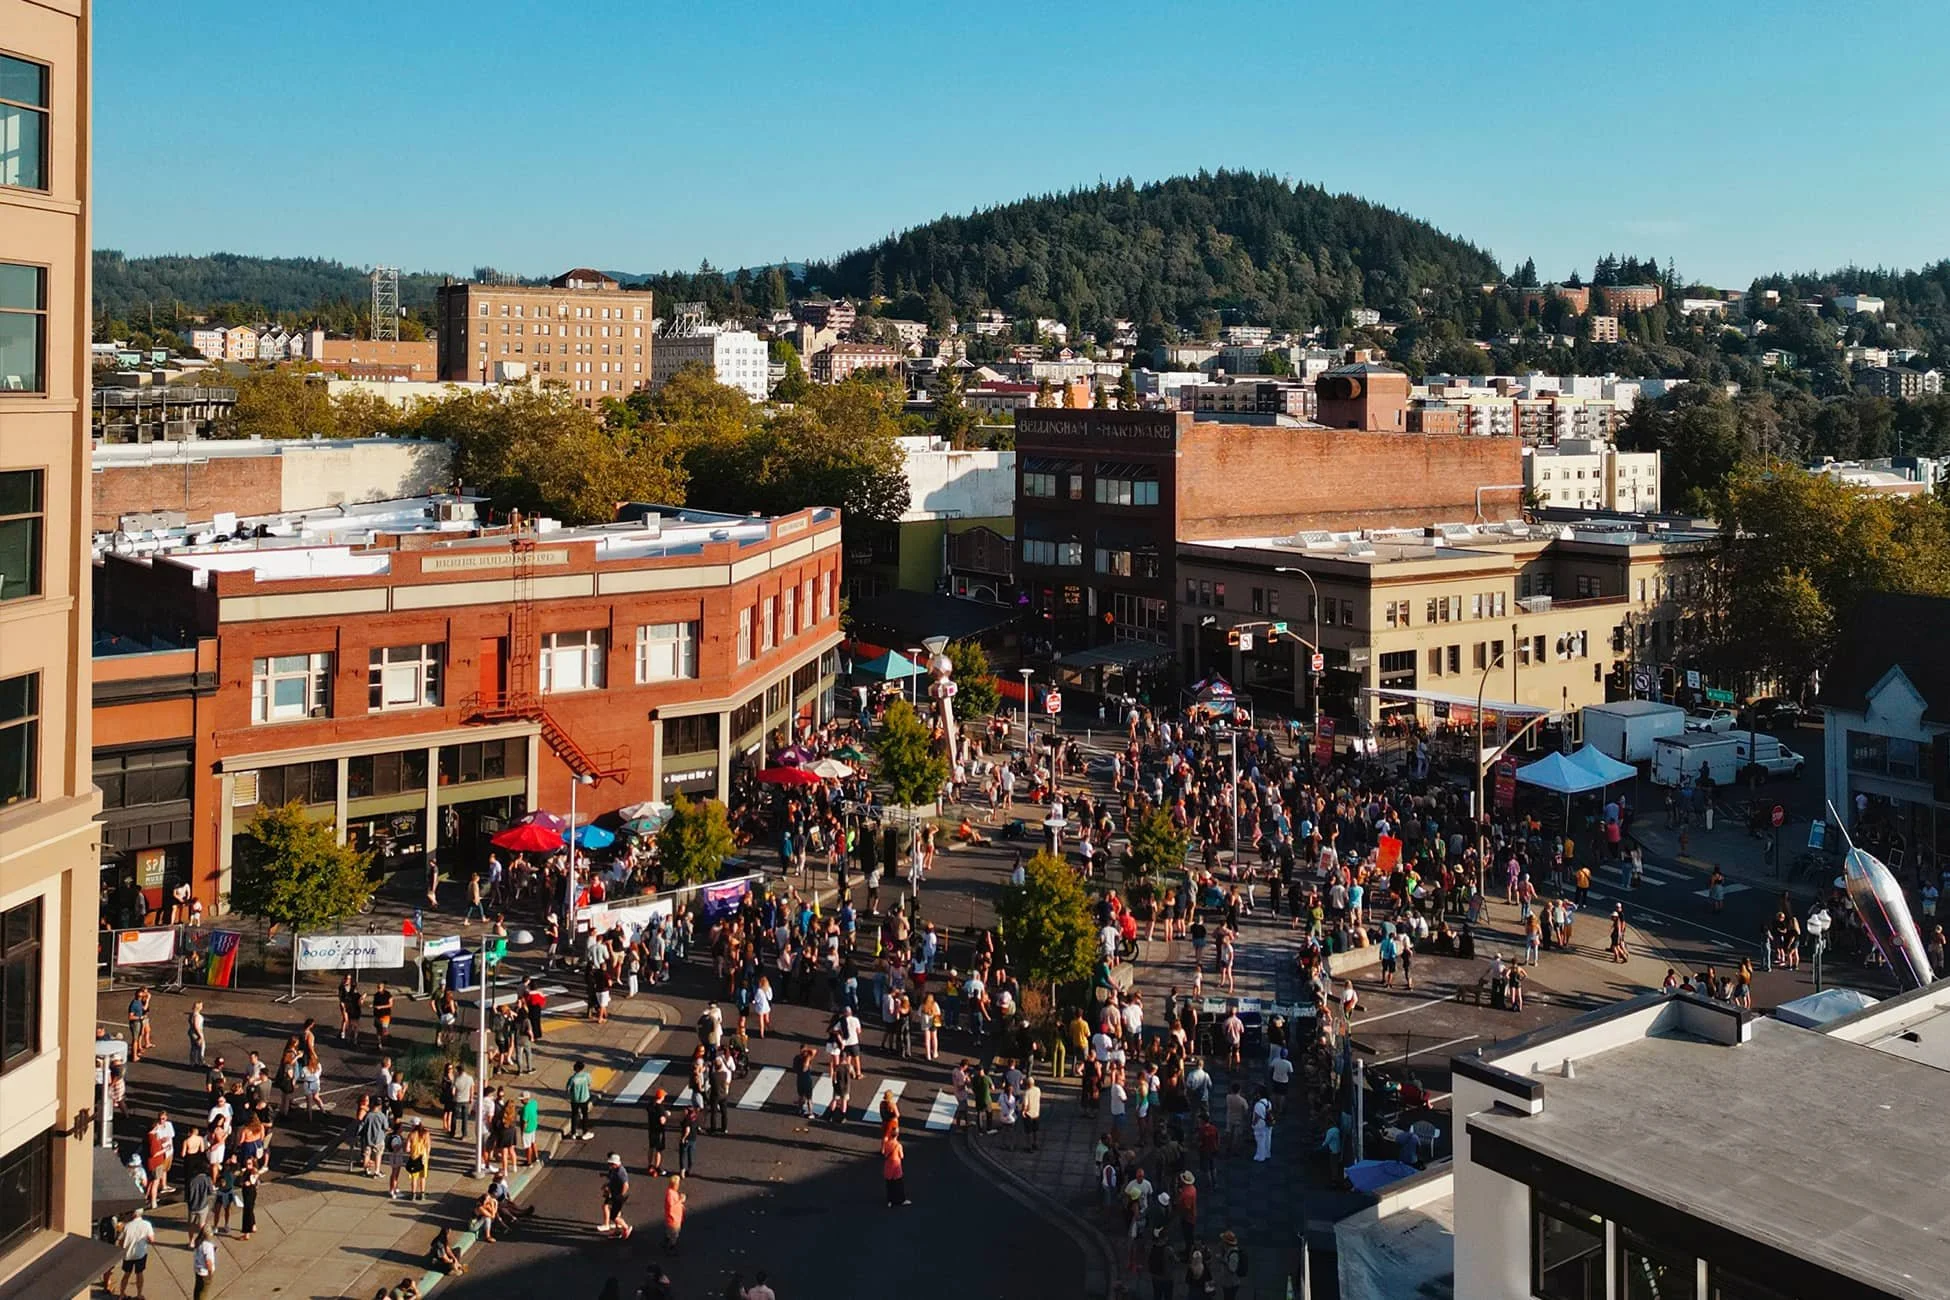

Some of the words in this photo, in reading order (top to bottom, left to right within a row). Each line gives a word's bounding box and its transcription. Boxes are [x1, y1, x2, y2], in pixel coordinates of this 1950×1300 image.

[1018, 419, 1088, 436] BELLINGHAM
[1095, 423, 1172, 439] HARDWARE
[303, 948, 336, 958] POGO
[346, 946, 377, 956] ZONE
